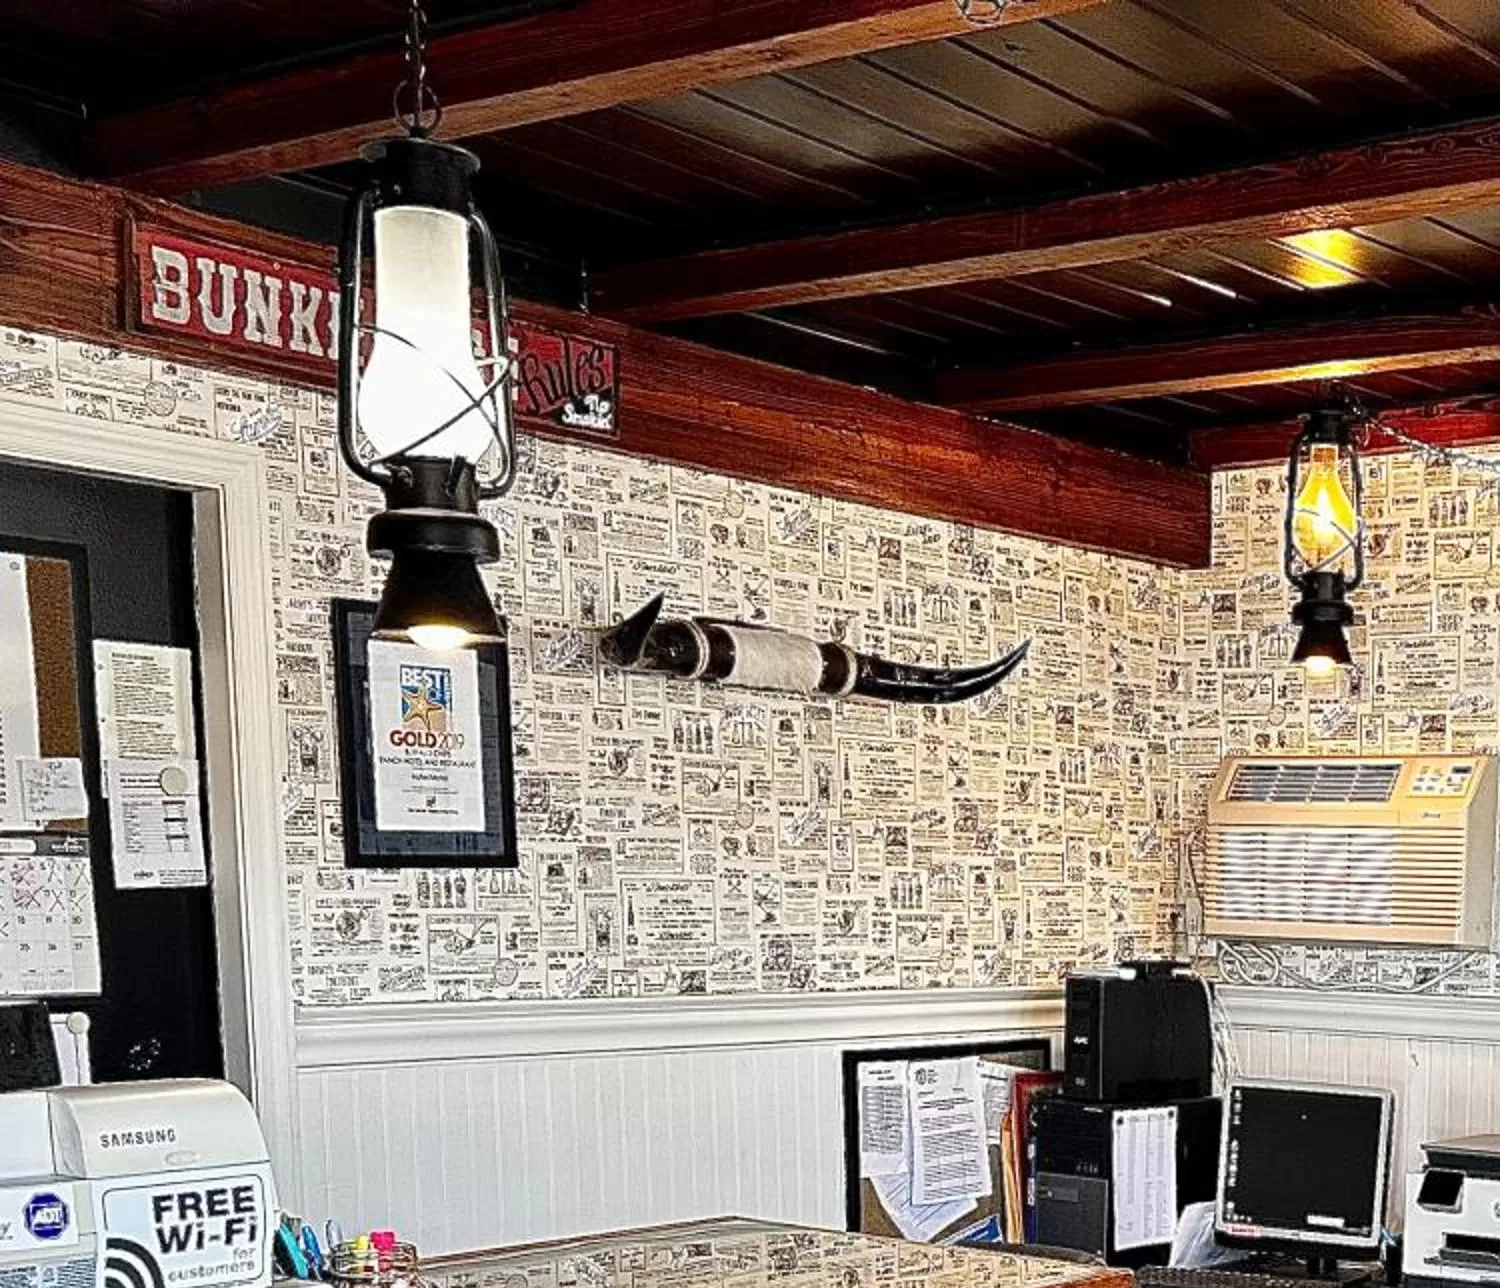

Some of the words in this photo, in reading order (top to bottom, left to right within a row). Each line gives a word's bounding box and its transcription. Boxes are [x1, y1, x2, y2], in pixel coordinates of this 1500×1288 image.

[519, 336, 606, 414] Rules
[401, 667, 449, 690] BEST
[389, 730, 437, 749] GOLD
[99, 1128, 177, 1148] SAMSUNG
[151, 1186, 256, 1224] FREE
[155, 1216, 258, 1255] Wi-Fi
[232, 1247, 255, 1261] for
[167, 1260, 256, 1283] customers
